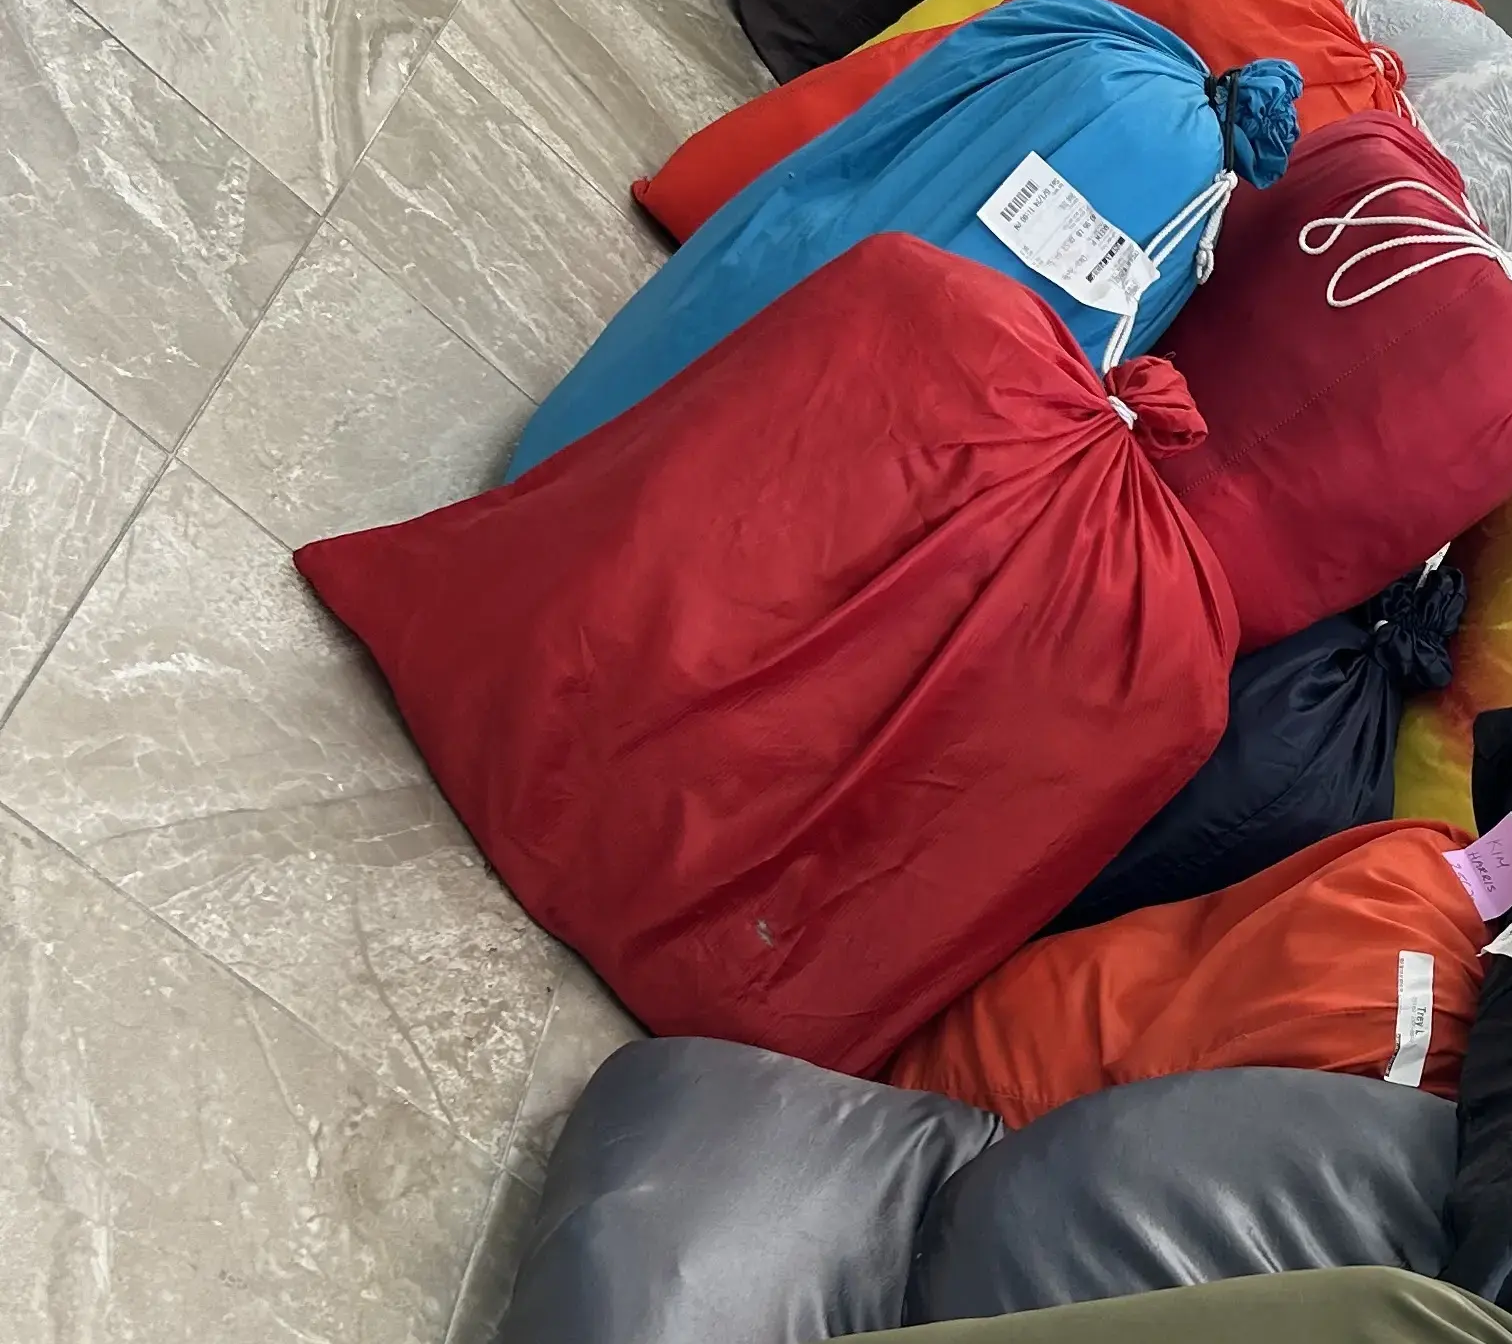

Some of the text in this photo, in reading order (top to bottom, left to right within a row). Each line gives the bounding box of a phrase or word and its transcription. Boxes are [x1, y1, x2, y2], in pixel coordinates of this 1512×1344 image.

[1485, 835, 1511, 868] KIM
[1467, 848, 1497, 894] HARRIS
[1414, 1005, 1427, 1027] Trey
